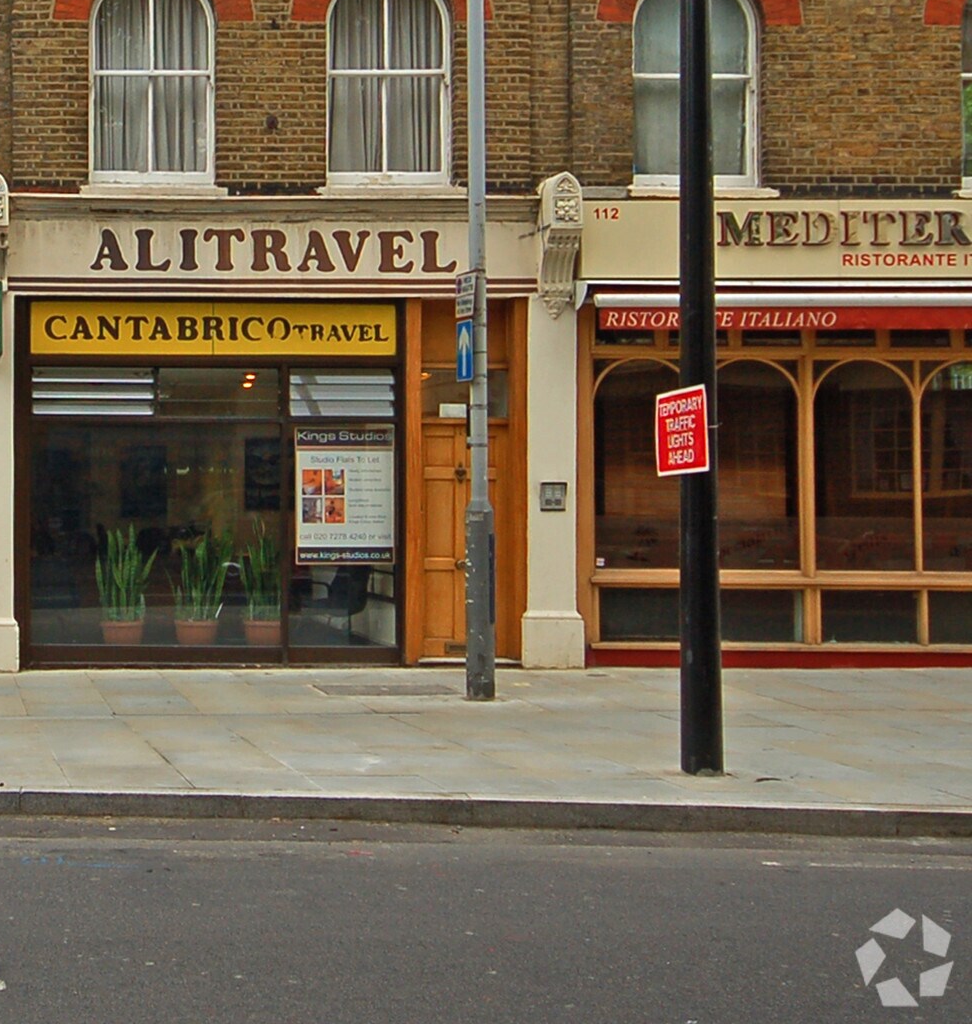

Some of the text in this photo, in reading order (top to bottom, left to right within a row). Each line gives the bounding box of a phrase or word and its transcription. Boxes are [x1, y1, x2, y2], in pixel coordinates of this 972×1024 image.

[594, 208, 620, 220] 112
[90, 227, 458, 274] ALITRAVEL
[842, 253, 957, 266] RISTORANTE
[740, 311, 837, 327] ITALIANO
[43, 314, 291, 342] CANTABRICO
[659, 395, 703, 417] TEMPORARY
[665, 414, 696, 432] TRAFFIC
[297, 431, 392, 443] Kings Studios
[667, 431, 694, 449] LIGHTS
[310, 456, 335, 464] Studio
[336, 456, 355, 464] Flats
[668, 448, 695, 465] AHEAD
[299, 551, 391, 561] www.kings-studios.co.uk
